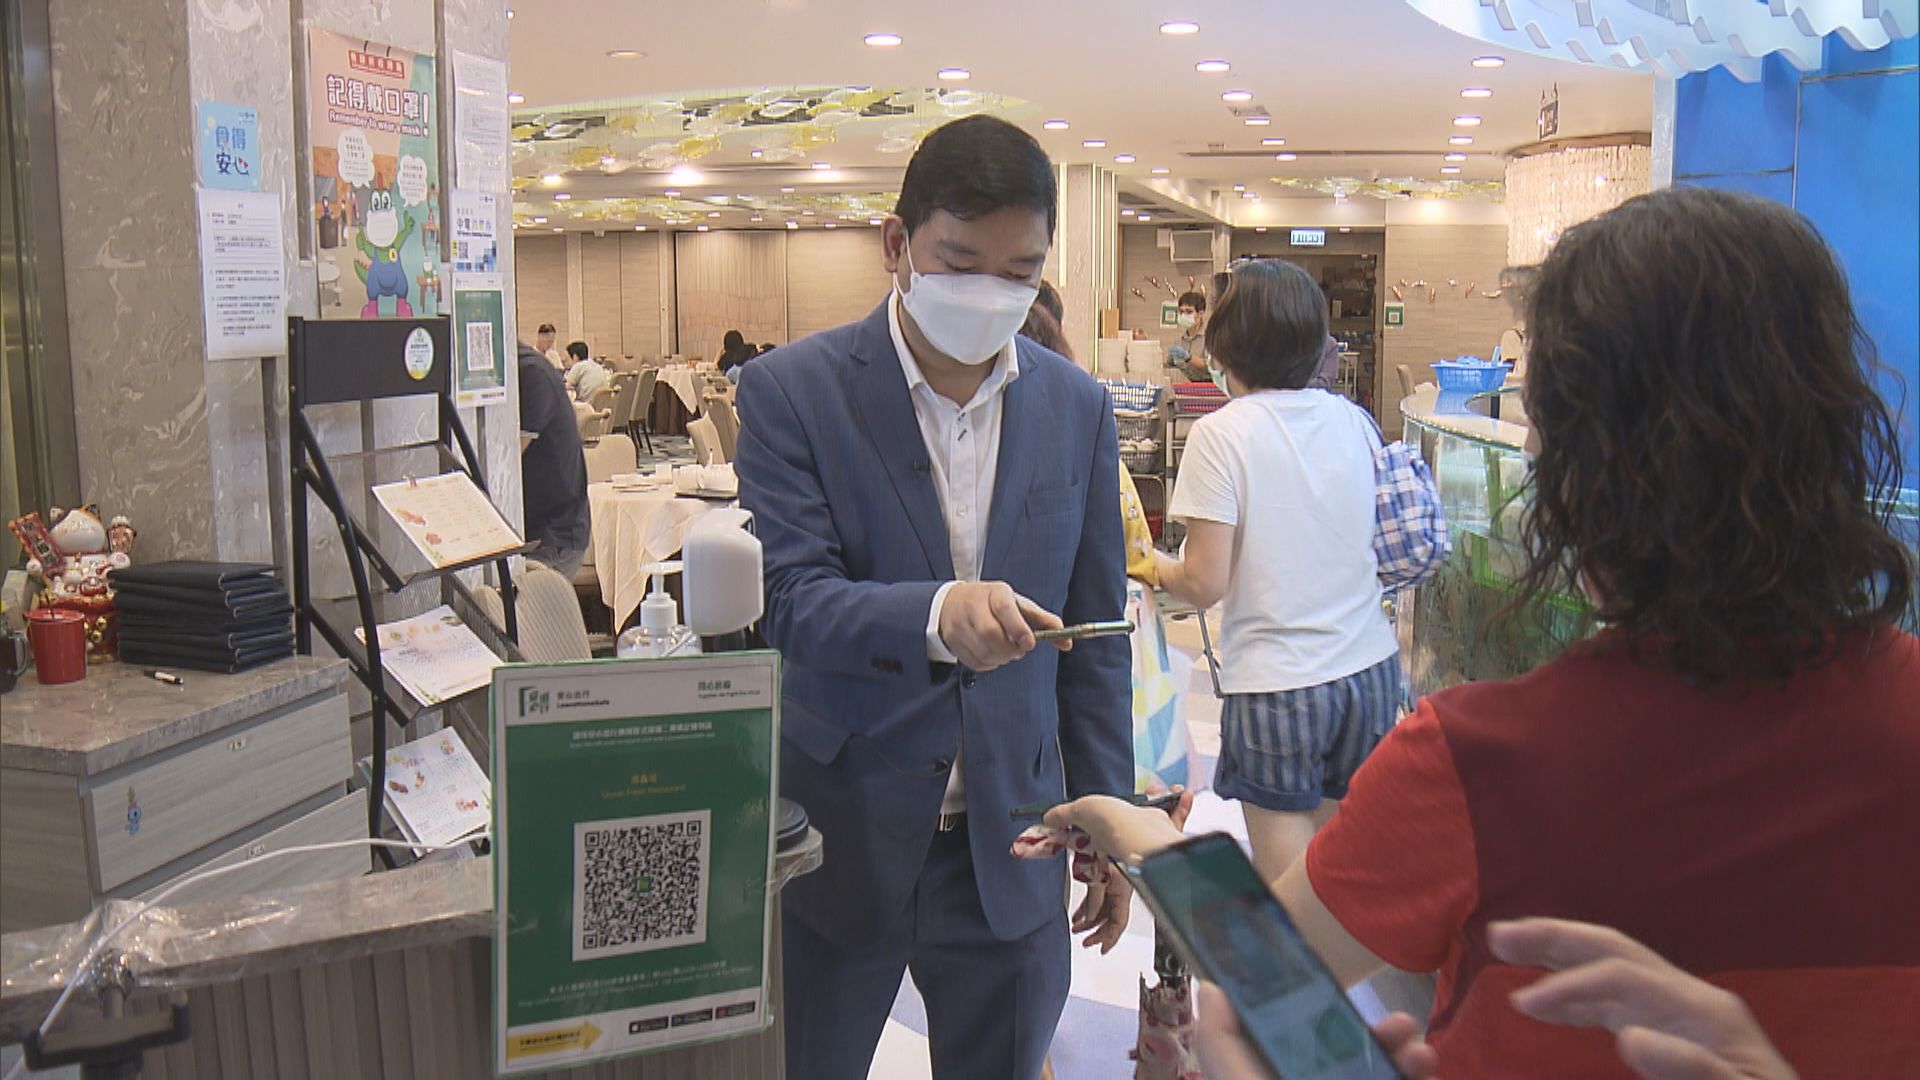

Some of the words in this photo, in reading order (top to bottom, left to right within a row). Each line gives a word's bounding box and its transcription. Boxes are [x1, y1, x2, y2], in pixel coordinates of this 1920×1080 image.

[329, 109, 368, 128] Remember
[368, 116, 377, 130] to
[377, 118, 395, 132] wear
